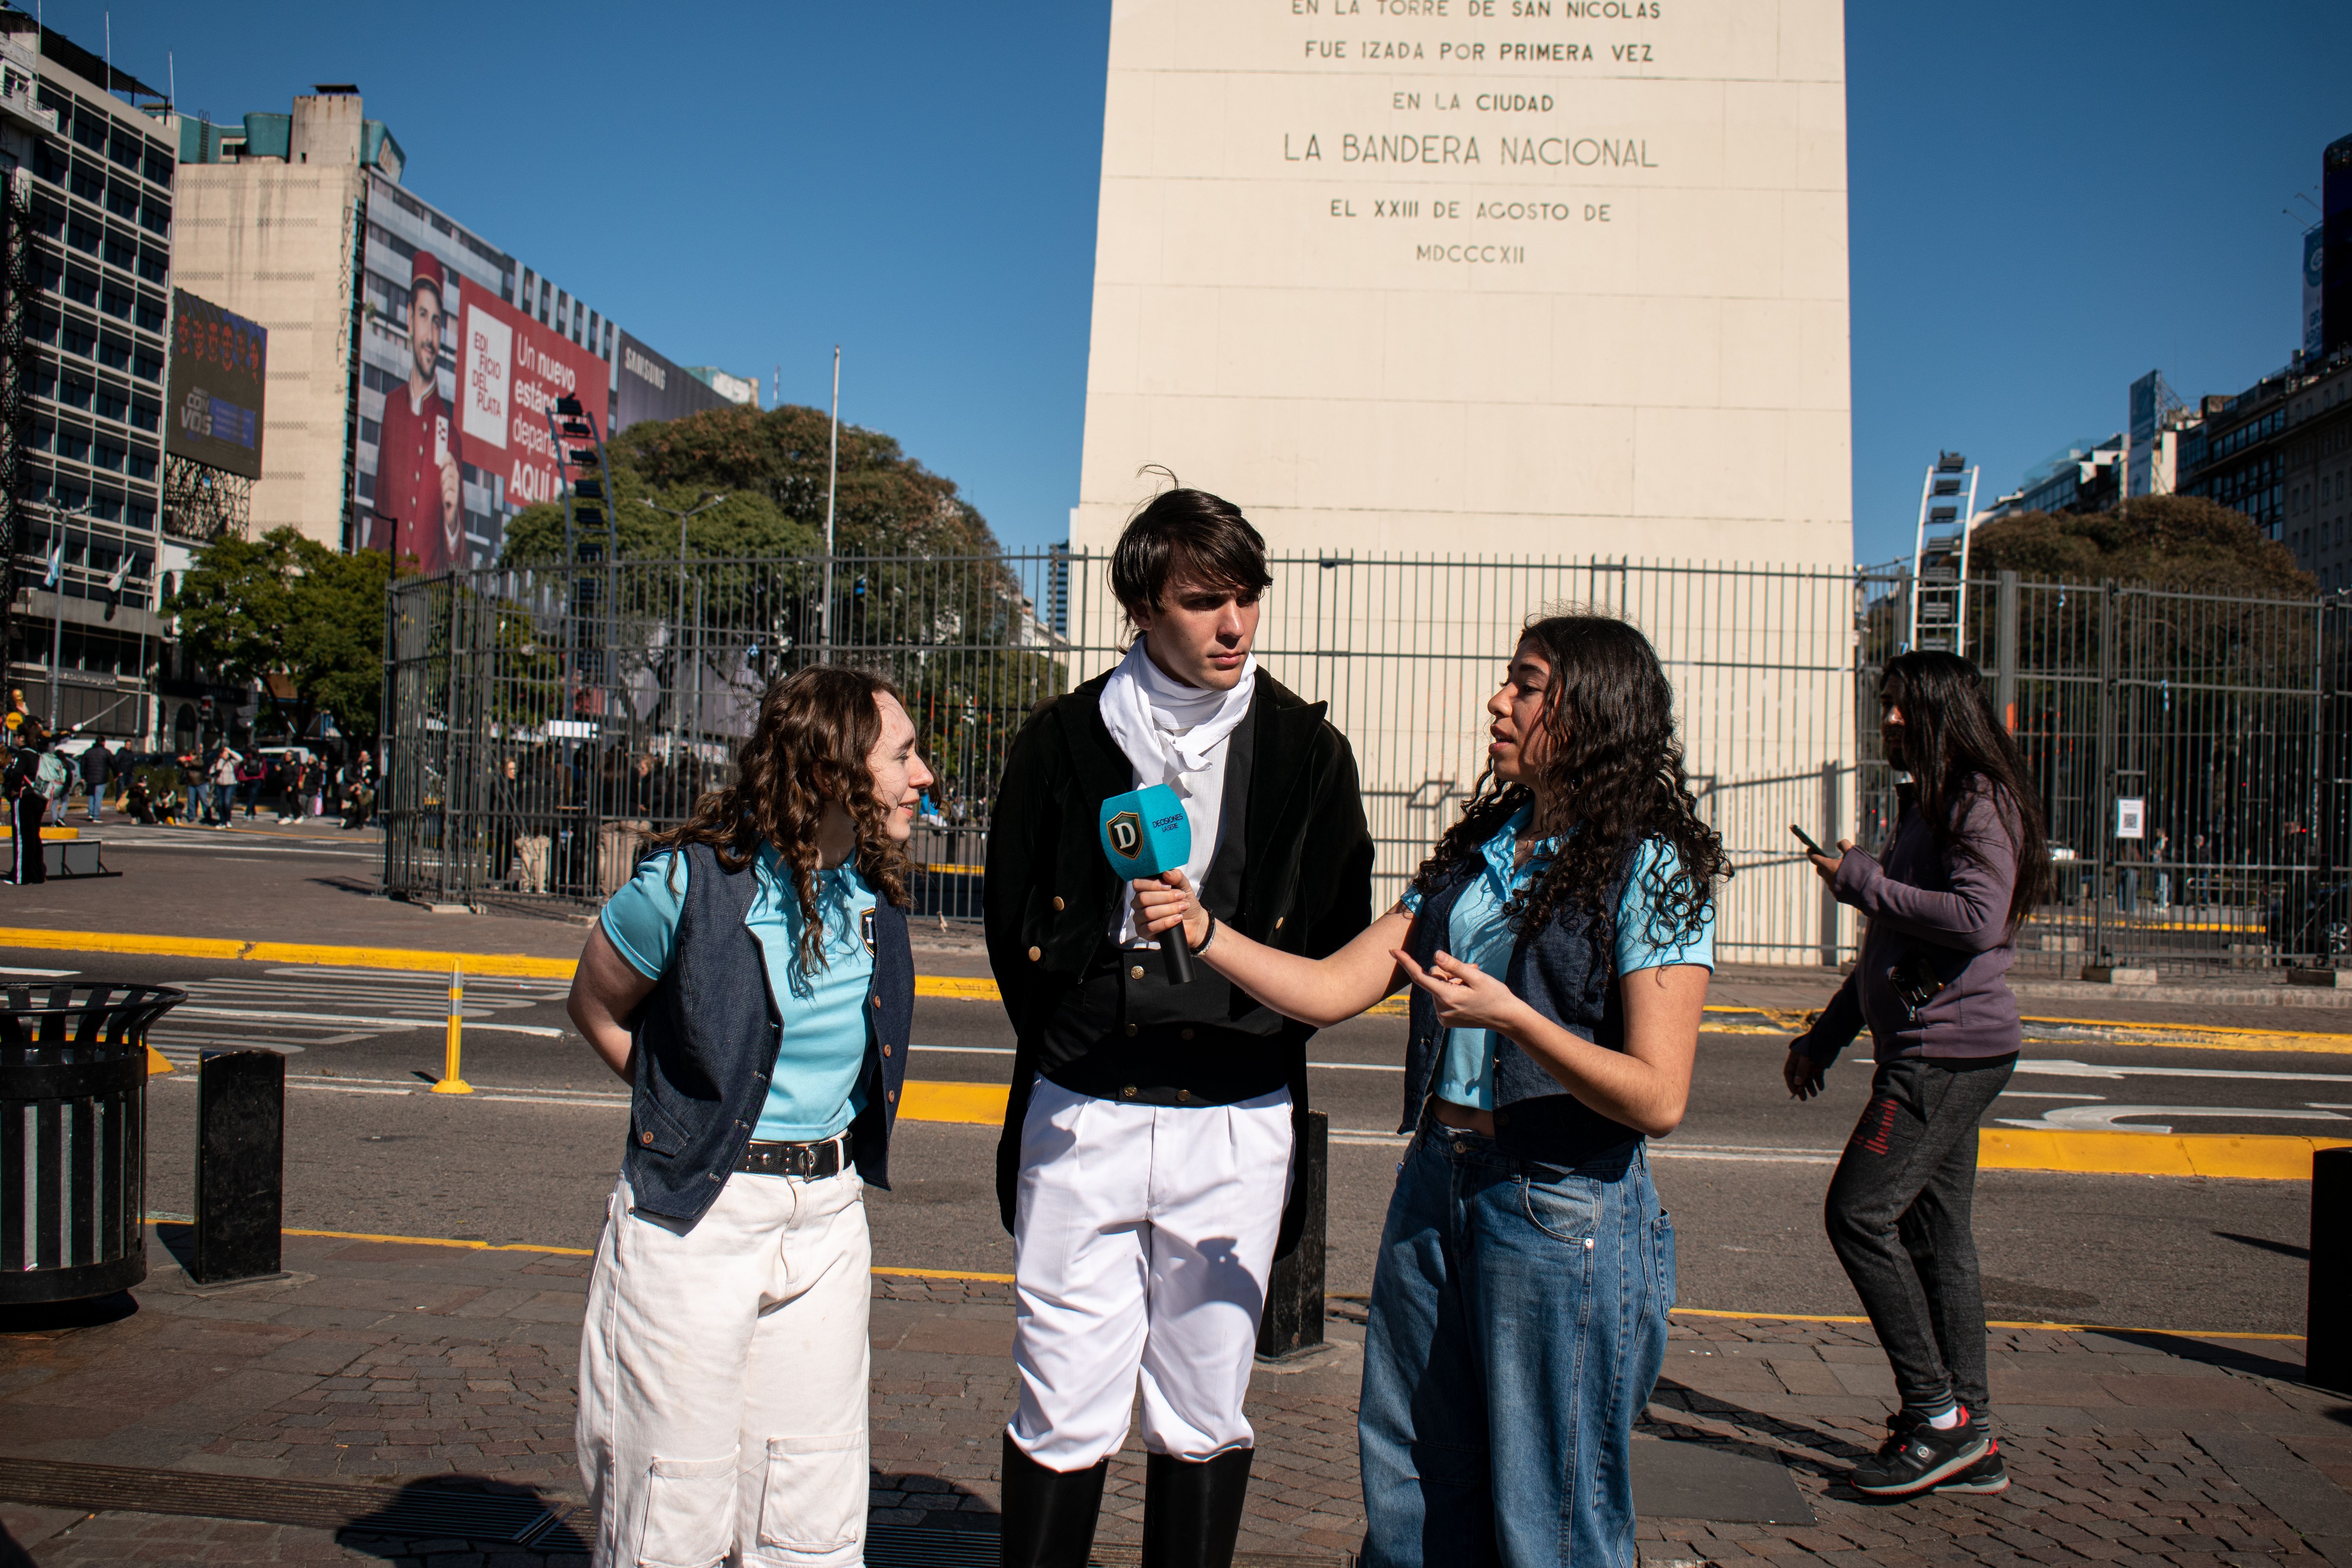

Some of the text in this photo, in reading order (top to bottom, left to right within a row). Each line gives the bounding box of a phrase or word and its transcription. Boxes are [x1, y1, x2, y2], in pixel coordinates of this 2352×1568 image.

[1292, 0, 1661, 19] EN LA TORRE DE SAN NICOLAS
[1305, 40, 1654, 62] FUE IZADA POR PRIMERA VEZ
[1393, 91, 1554, 112] EN LA CIUDAD
[1284, 132, 1659, 168] LA BANDERA NACIONAL
[1330, 199, 1611, 222] EL XXIII DE AGOSTO DE
[1416, 243, 1524, 265] MDCCCXII
[475, 331, 488, 354] EDI
[479, 354, 501, 380] FICIO
[517, 332, 576, 392] Un nuevo
[625, 347, 666, 390] SAMSUNG
[472, 369, 488, 392] DEL
[478, 392, 502, 418] PLATA
[181, 405, 213, 436] VOS
[1152, 813, 1183, 828] DECISIONES
[1114, 822, 1136, 849] D
